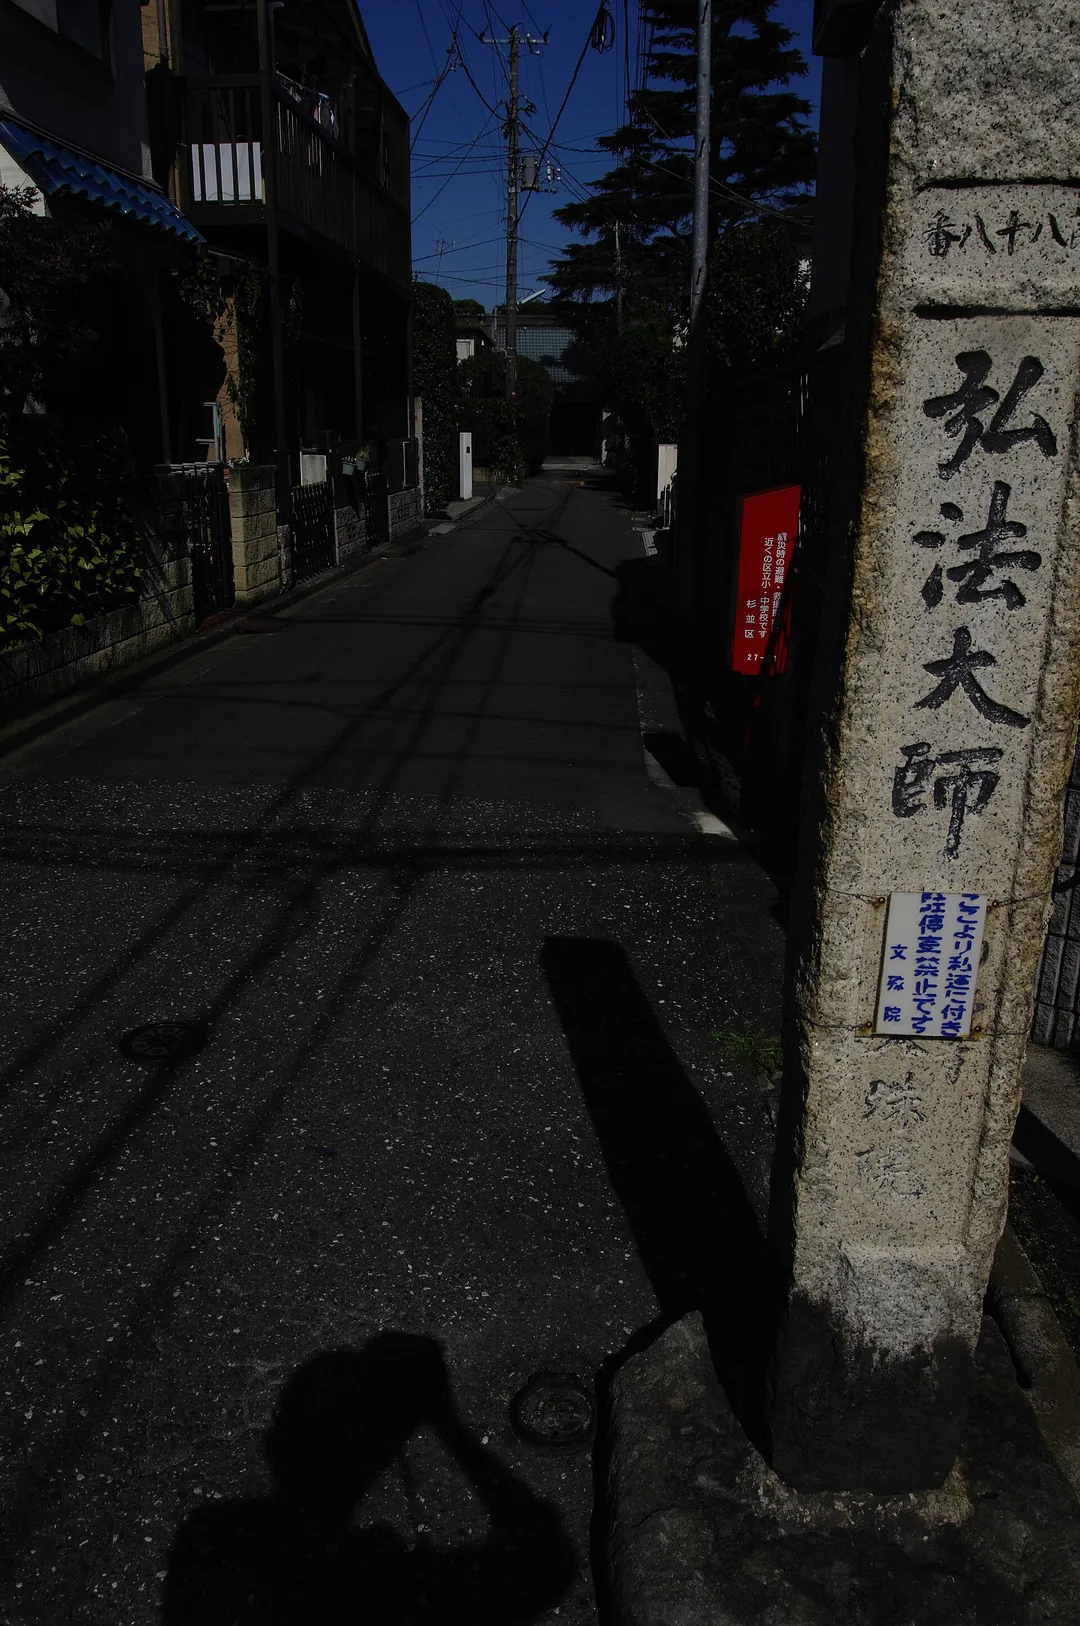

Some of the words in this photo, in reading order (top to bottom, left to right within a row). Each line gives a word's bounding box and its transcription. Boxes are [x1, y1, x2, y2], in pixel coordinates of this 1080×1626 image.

[744, 600, 757, 639] 杉並区
[758, 537, 774, 639] 近くの区立小・中学校です
[891, 349, 1058, 861] 弘法大師
[911, 892, 947, 1034] 駐停車禁止です
[940, 893, 980, 1037] ここより私道に付き
[855, 1038, 929, 1200] 殊院
